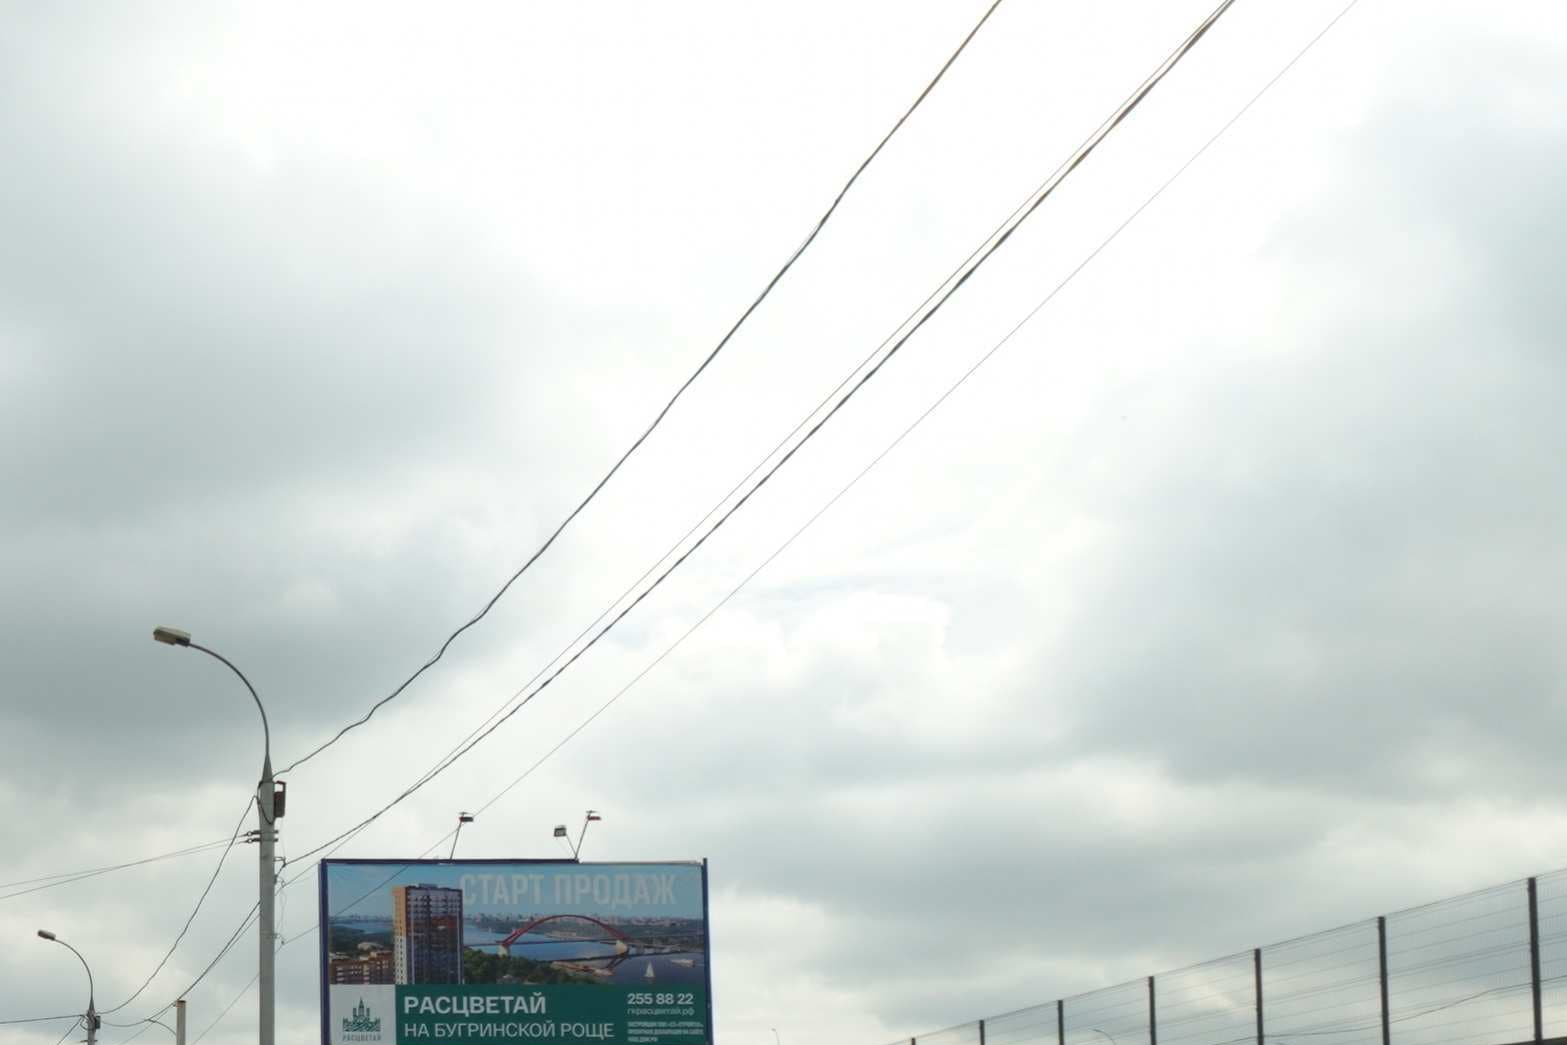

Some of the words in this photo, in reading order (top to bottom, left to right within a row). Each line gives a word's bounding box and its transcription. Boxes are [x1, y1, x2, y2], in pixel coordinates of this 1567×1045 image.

[458, 873, 545, 905] СТАРТ
[555, 873, 678, 909] ПРОДАЖ
[403, 992, 547, 1018] РАСЦВЕТАЙ
[627, 993, 653, 1005] 255
[655, 993, 675, 1005] 88
[676, 993, 694, 1005] 22
[403, 1022, 429, 1038] НА
[434, 1019, 556, 1038] БУГРИНСКОЙ
[561, 1022, 615, 1040] РОЩЕ
